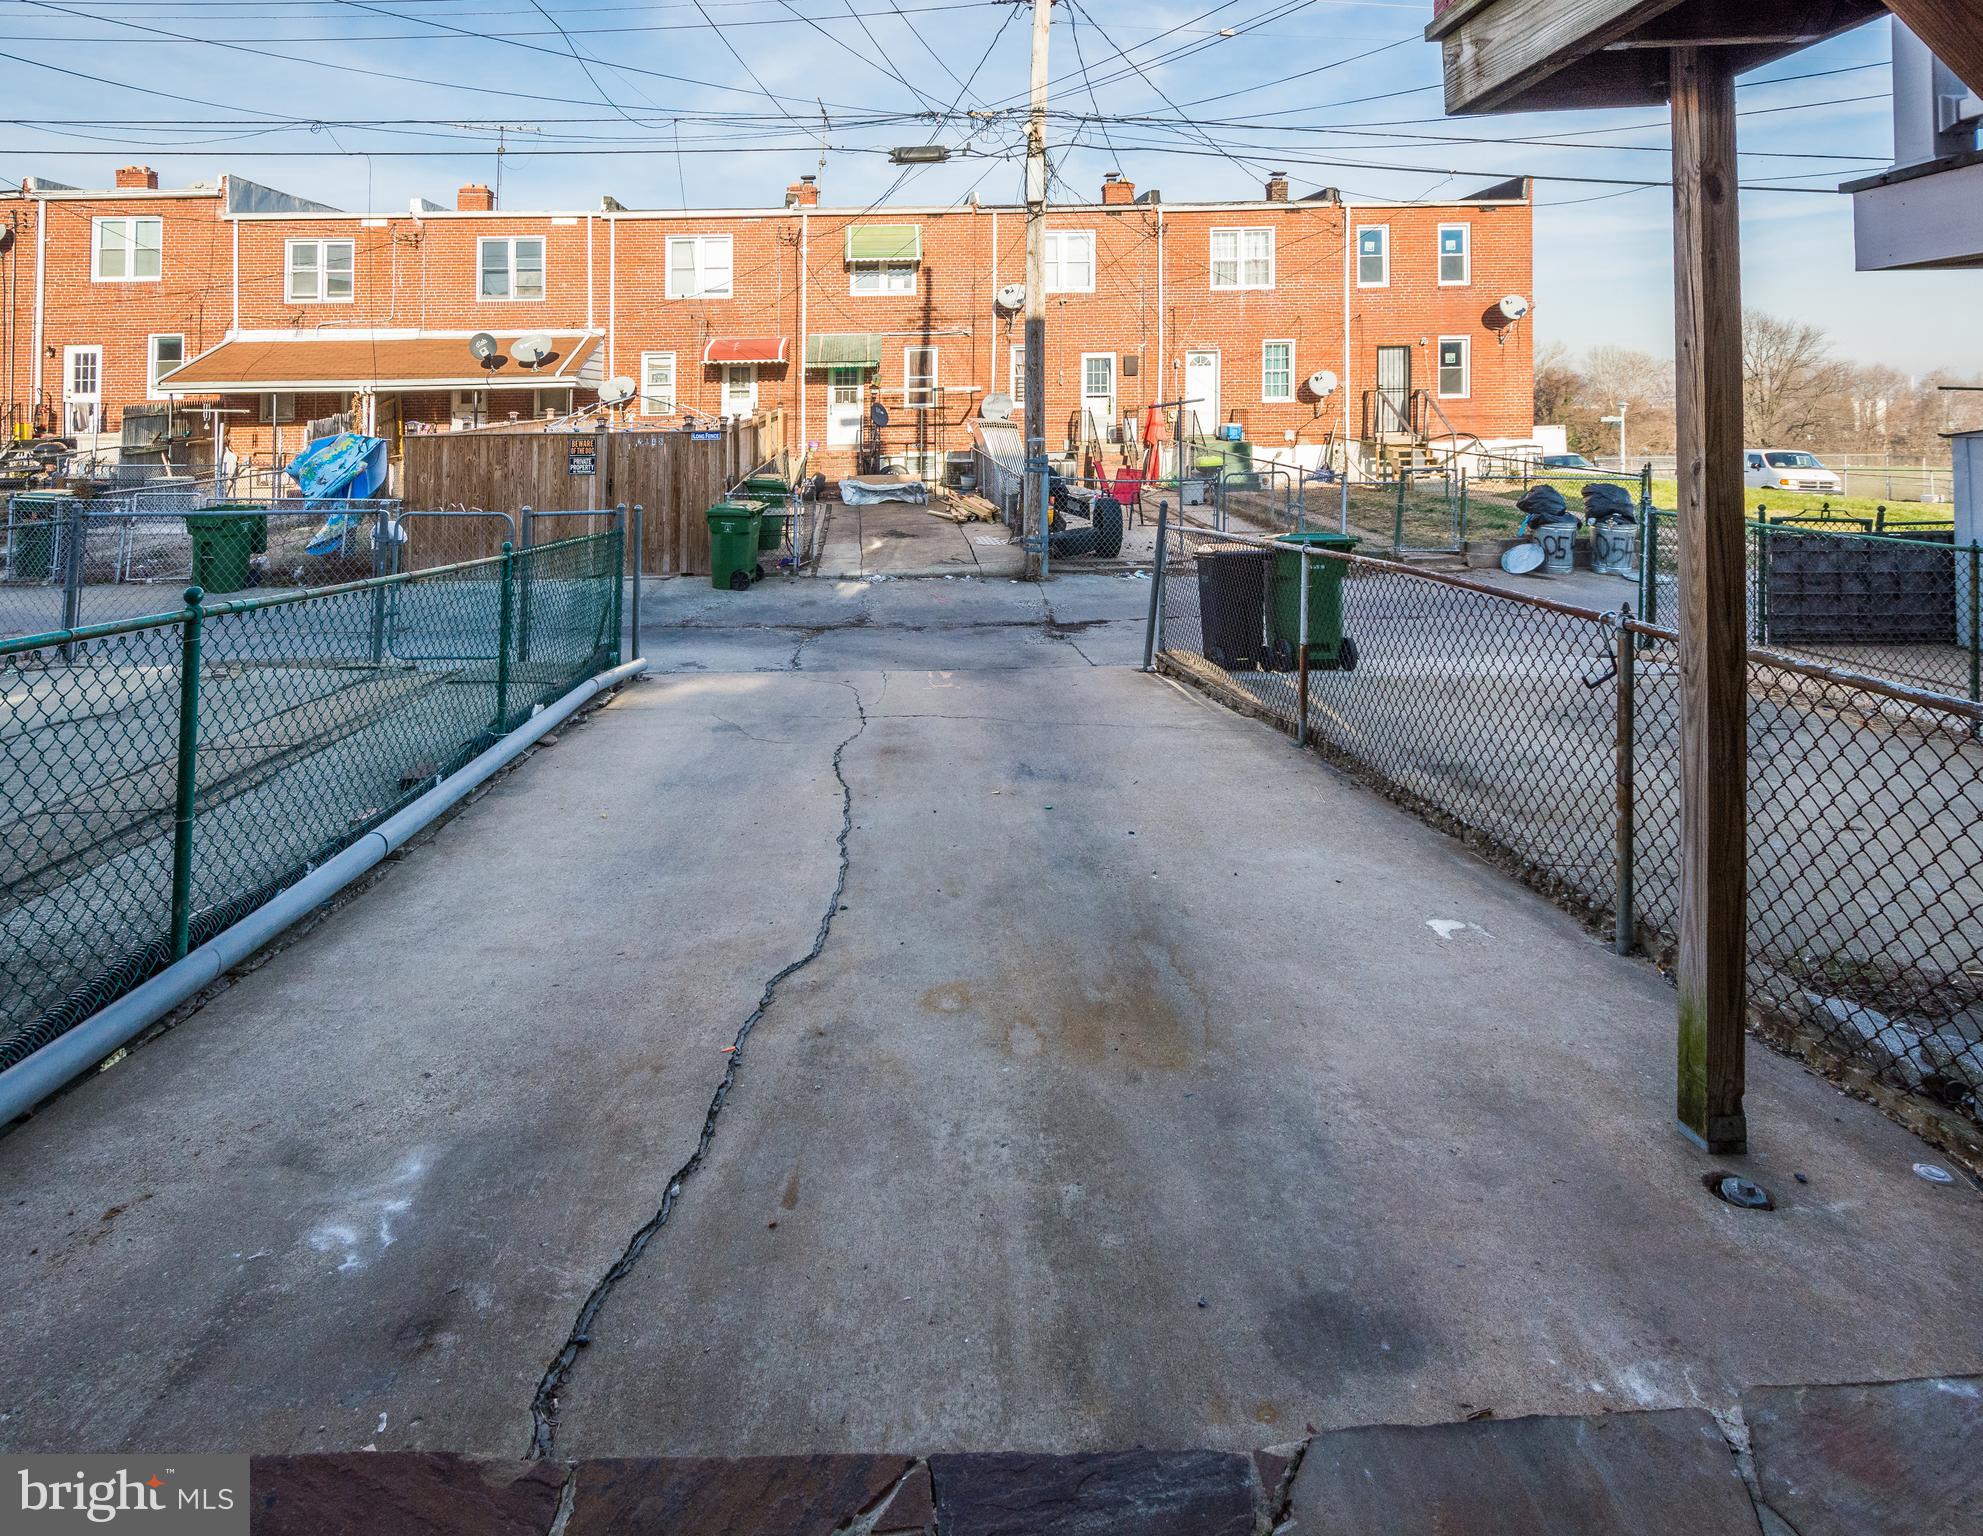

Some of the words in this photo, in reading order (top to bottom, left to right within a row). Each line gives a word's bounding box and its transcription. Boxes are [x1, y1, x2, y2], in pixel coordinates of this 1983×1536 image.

[571, 440, 594, 448] BEWARE
[570, 447, 577, 455] OF
[577, 447, 585, 455] THE
